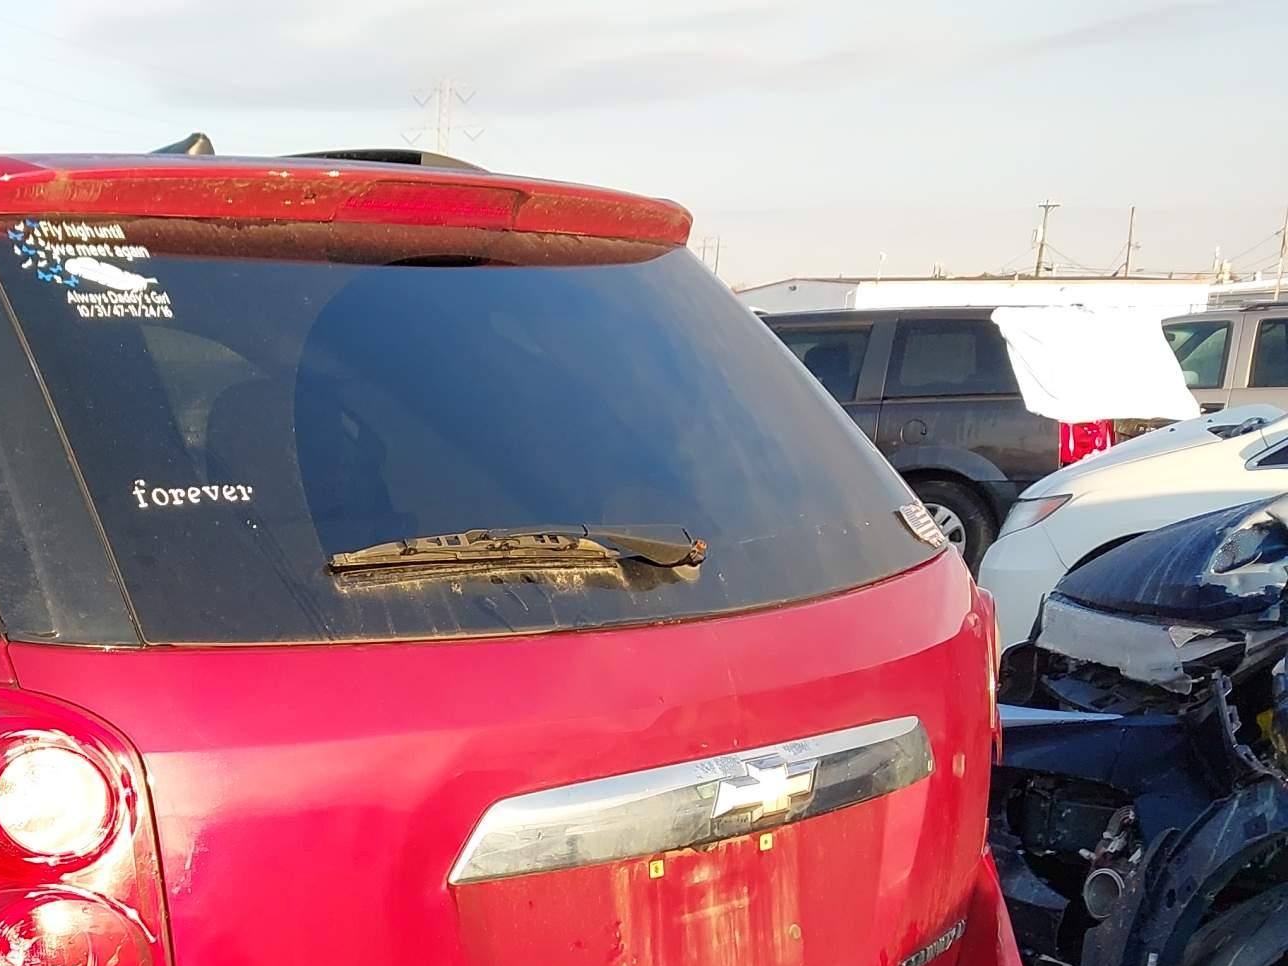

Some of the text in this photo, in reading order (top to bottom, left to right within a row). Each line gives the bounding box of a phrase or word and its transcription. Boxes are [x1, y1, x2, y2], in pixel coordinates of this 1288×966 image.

[39, 220, 126, 241] Fly high until
[54, 243, 150, 262] we meet again
[67, 290, 171, 306] Always Daddy's Girl
[132, 479, 253, 508] forever
